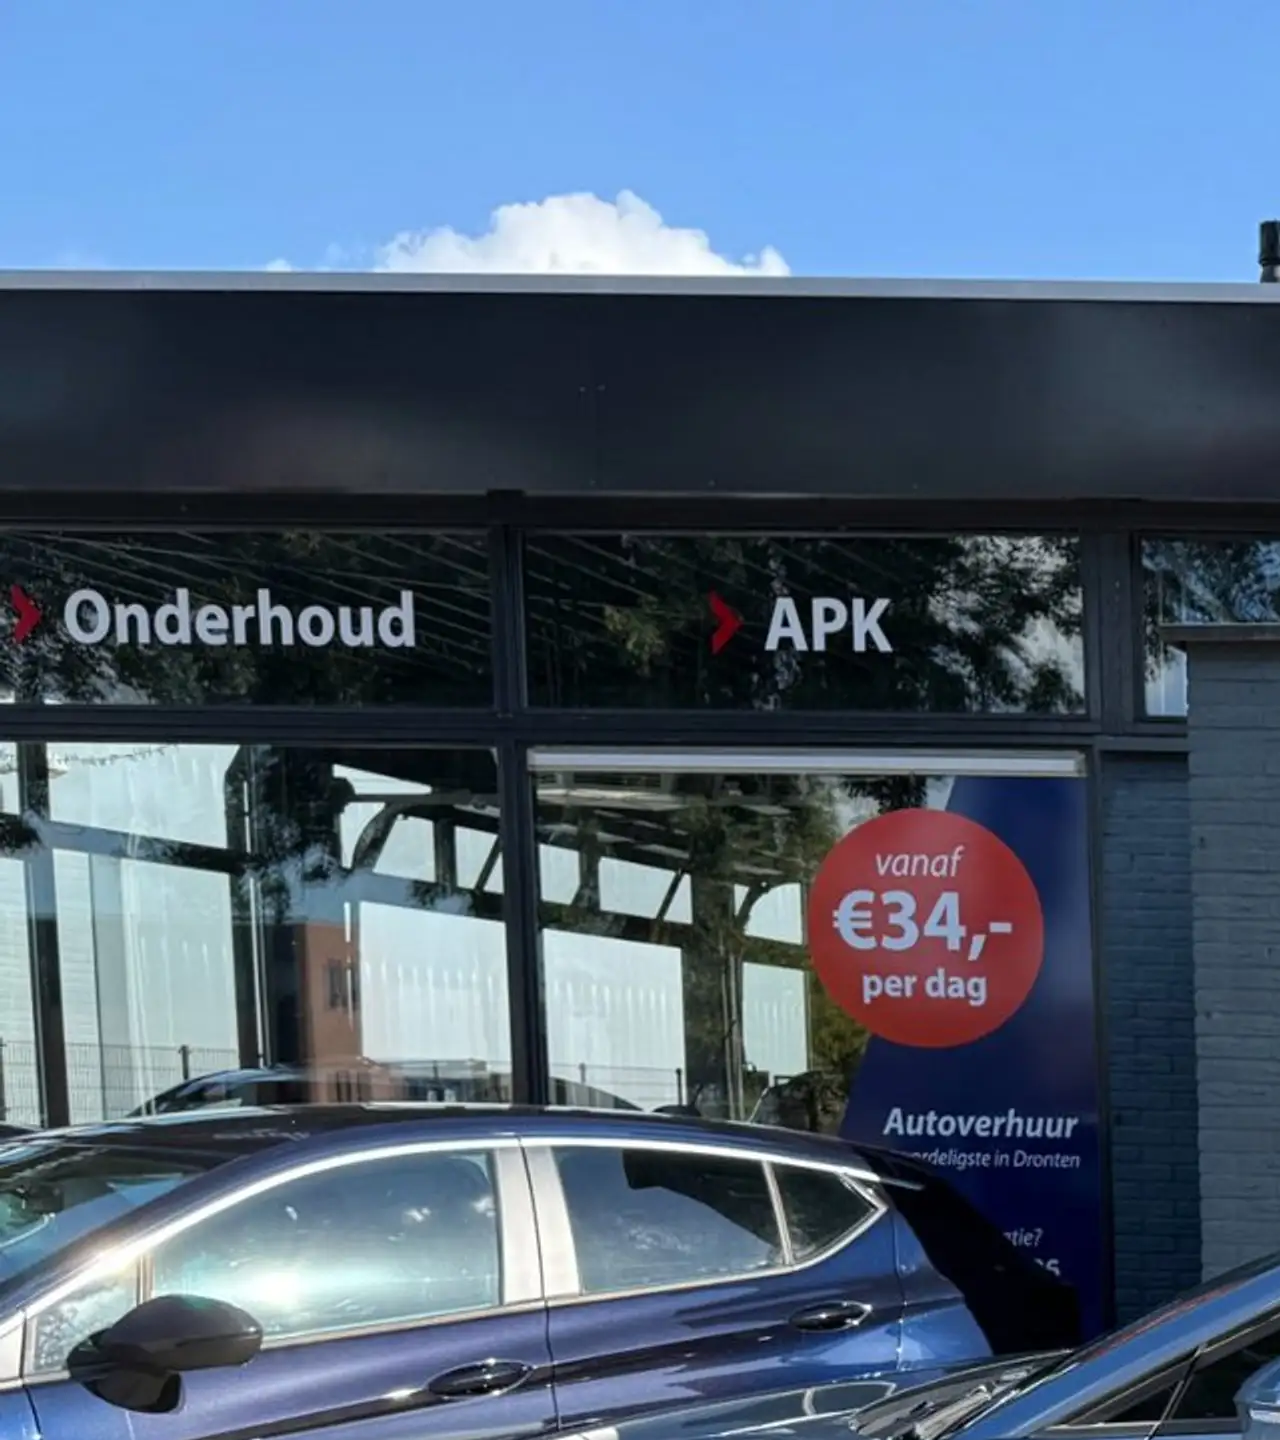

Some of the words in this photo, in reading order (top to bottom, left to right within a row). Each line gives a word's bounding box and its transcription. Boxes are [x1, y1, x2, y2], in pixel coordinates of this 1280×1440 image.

[63, 588, 418, 649] Onderhoud
[763, 595, 893, 655] APK
[875, 844, 966, 878] vanaf
[832, 889, 1013, 962] €34,-
[862, 972, 918, 1005] per
[924, 967, 988, 1007] dag
[883, 1107, 1079, 1139] Autoverhuur
[993, 1150, 1010, 1167] in
[1012, 1149, 1082, 1169] Dronten
